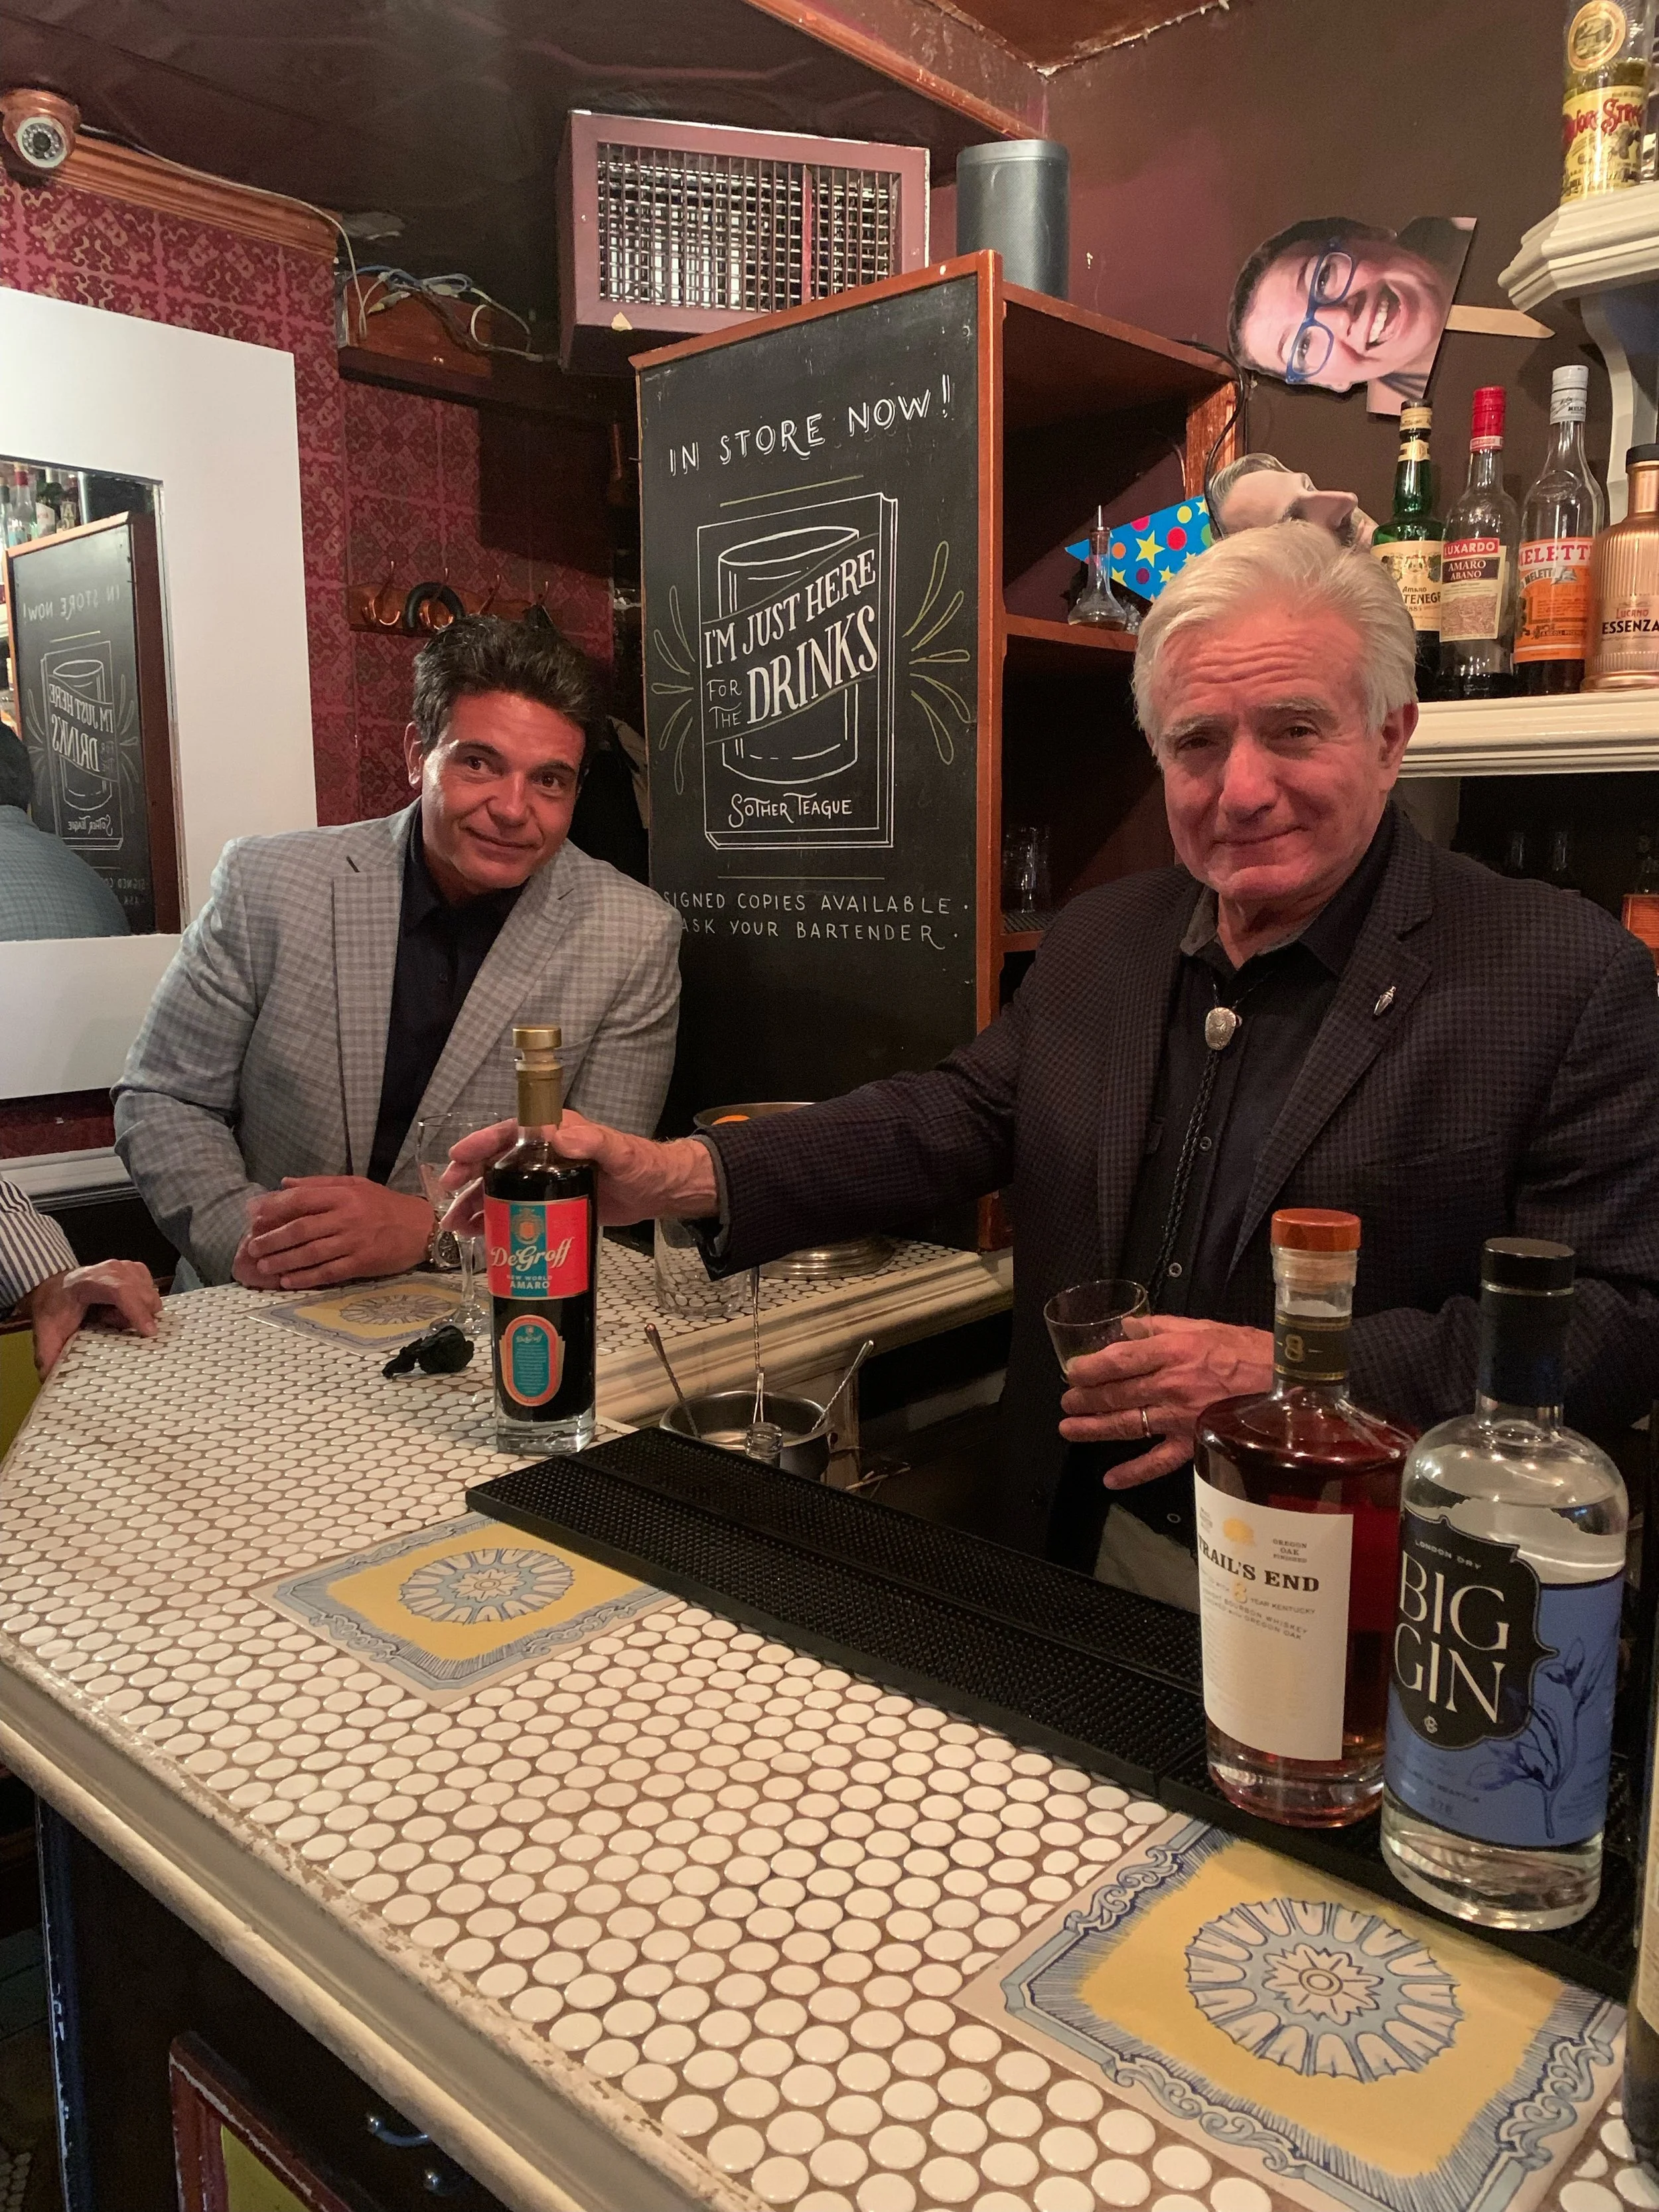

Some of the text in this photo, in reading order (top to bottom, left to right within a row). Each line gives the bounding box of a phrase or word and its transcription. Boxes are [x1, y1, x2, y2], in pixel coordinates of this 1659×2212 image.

[670, 374, 950, 476] IN STORE NOW!
[1445, 541, 1495, 557] LUXARDO
[1448, 559, 1486, 572] AMARO
[1450, 570, 1482, 581] ABANO
[704, 549, 876, 668] I'M JUST HERE
[1602, 619, 1659, 634] ESSENZA
[747, 605, 877, 724] DRINKS
[706, 679, 742, 701] FOR
[709, 701, 742, 729] THE
[784, 792, 852, 819] TEAGUE
[664, 891, 725, 910] SIGNED
[738, 893, 806, 911] COPIES
[682, 918, 946, 950] ASK YOUR BARTENDER
[490, 1236, 575, 1272] DeGroff
[1285, 1334, 1304, 1362] 8
[1273, 1538, 1307, 1548] OREGON
[1280, 1547, 1299, 1556] OAK
[1415, 1539, 1481, 1570] LONDON DRY
[1198, 1533, 1256, 1581] TRAIL'S
[1264, 1570, 1320, 1592] END
[1250, 1597, 1269, 1607] YEAR
[1271, 1601, 1316, 1615] KENTUCKY
[1399, 1550, 1510, 1651] BIG
[1224, 1598, 1262, 1618] BOURBON
[1266, 1616, 1308, 1634] WHISKEY
[1283, 1630, 1301, 1640] OAK
[1395, 1623, 1506, 1723] GIN
